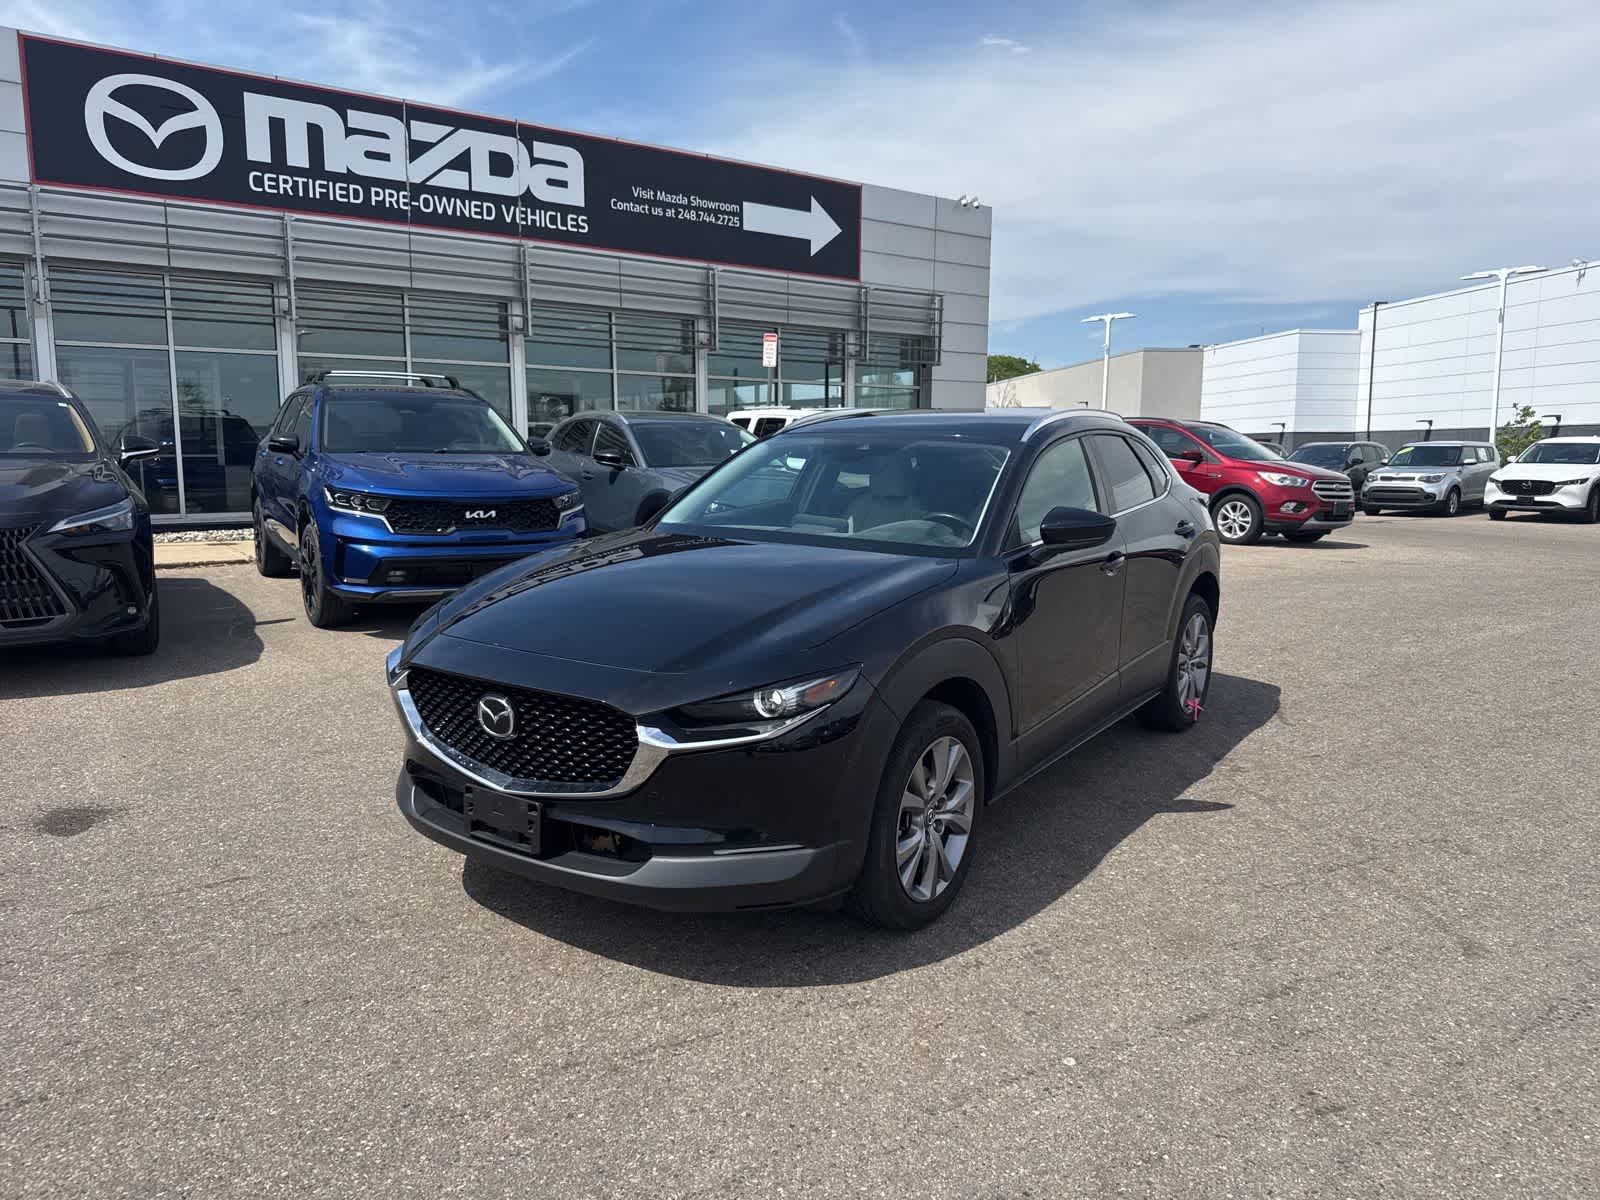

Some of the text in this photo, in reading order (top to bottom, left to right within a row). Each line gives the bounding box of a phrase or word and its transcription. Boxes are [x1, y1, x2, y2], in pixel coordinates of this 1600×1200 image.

[248, 171, 589, 233] CERTIFIED PRE-OWNED VEHICLES
[610, 198, 740, 227] Contact us at 248.744.2725
[631, 186, 740, 213] Visit Mazda Showroom
